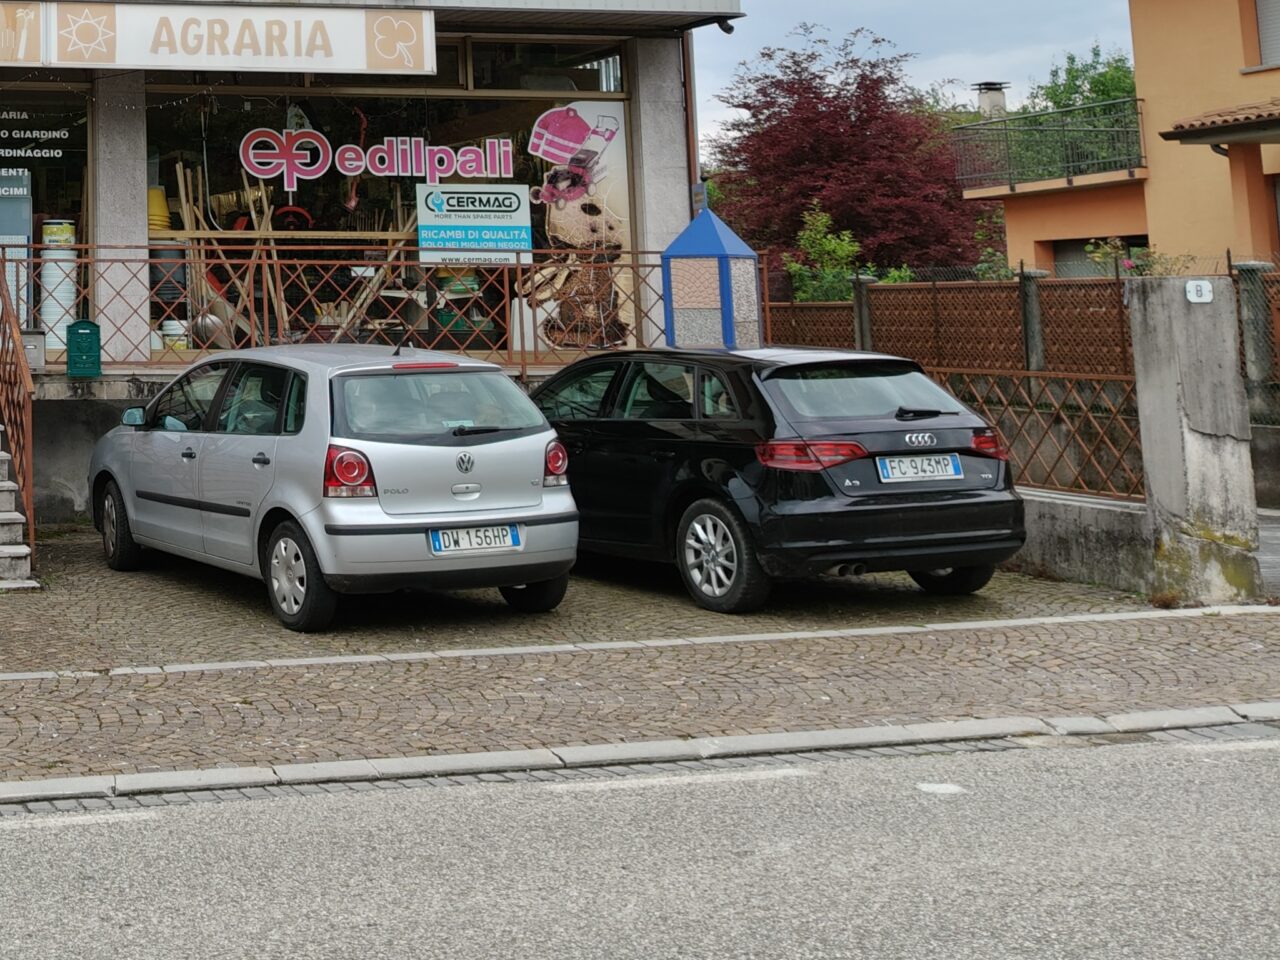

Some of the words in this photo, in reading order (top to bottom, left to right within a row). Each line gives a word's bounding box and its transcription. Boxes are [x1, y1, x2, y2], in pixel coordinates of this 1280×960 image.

[149, 15, 334, 58] AGRARIA
[12, 130, 69, 139] GIARDINO
[335, 137, 514, 186] edilpali
[446, 196, 513, 209] CERMAG
[421, 230, 465, 239] RICAMBI
[468, 230, 478, 239] DI
[461, 241, 496, 249] MIGLIORI
[498, 241, 528, 249] NEGOZI
[888, 459, 907, 476] FC
[909, 457, 950, 475] 943MP
[441, 530, 460, 549] DW
[465, 527, 509, 547] 156HP
